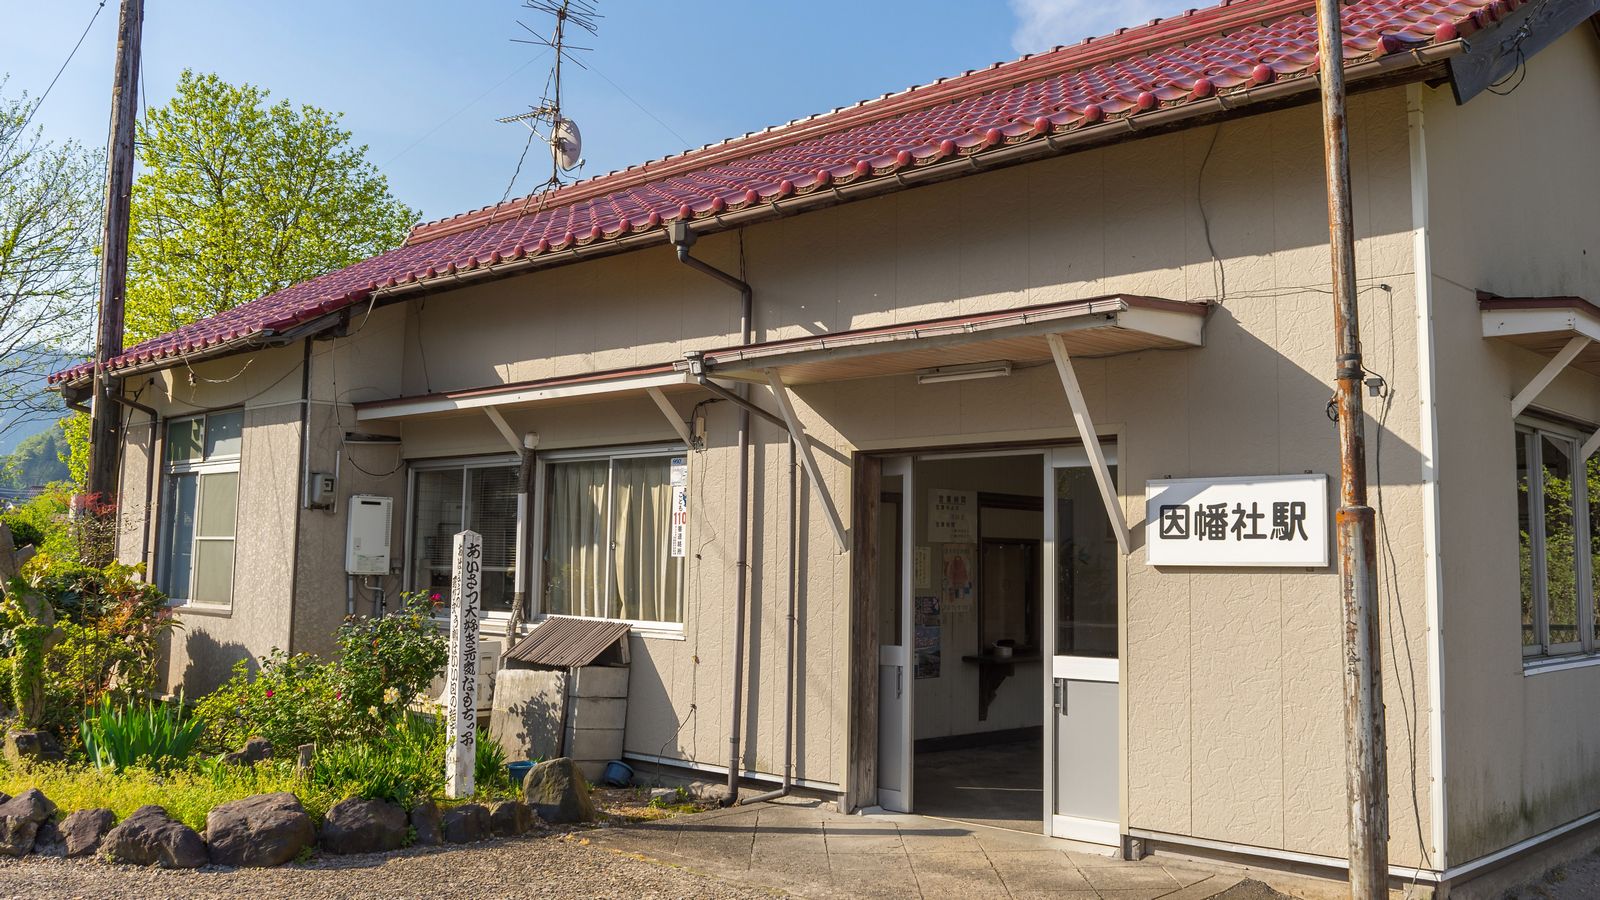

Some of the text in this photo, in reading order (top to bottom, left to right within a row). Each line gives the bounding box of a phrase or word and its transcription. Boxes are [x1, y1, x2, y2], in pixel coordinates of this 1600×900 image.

[674, 512, 687, 525] 110
[1160, 502, 1308, 541] 因幡社駅
[460, 543, 480, 745] あいさつ大好き元気なもちっ子
